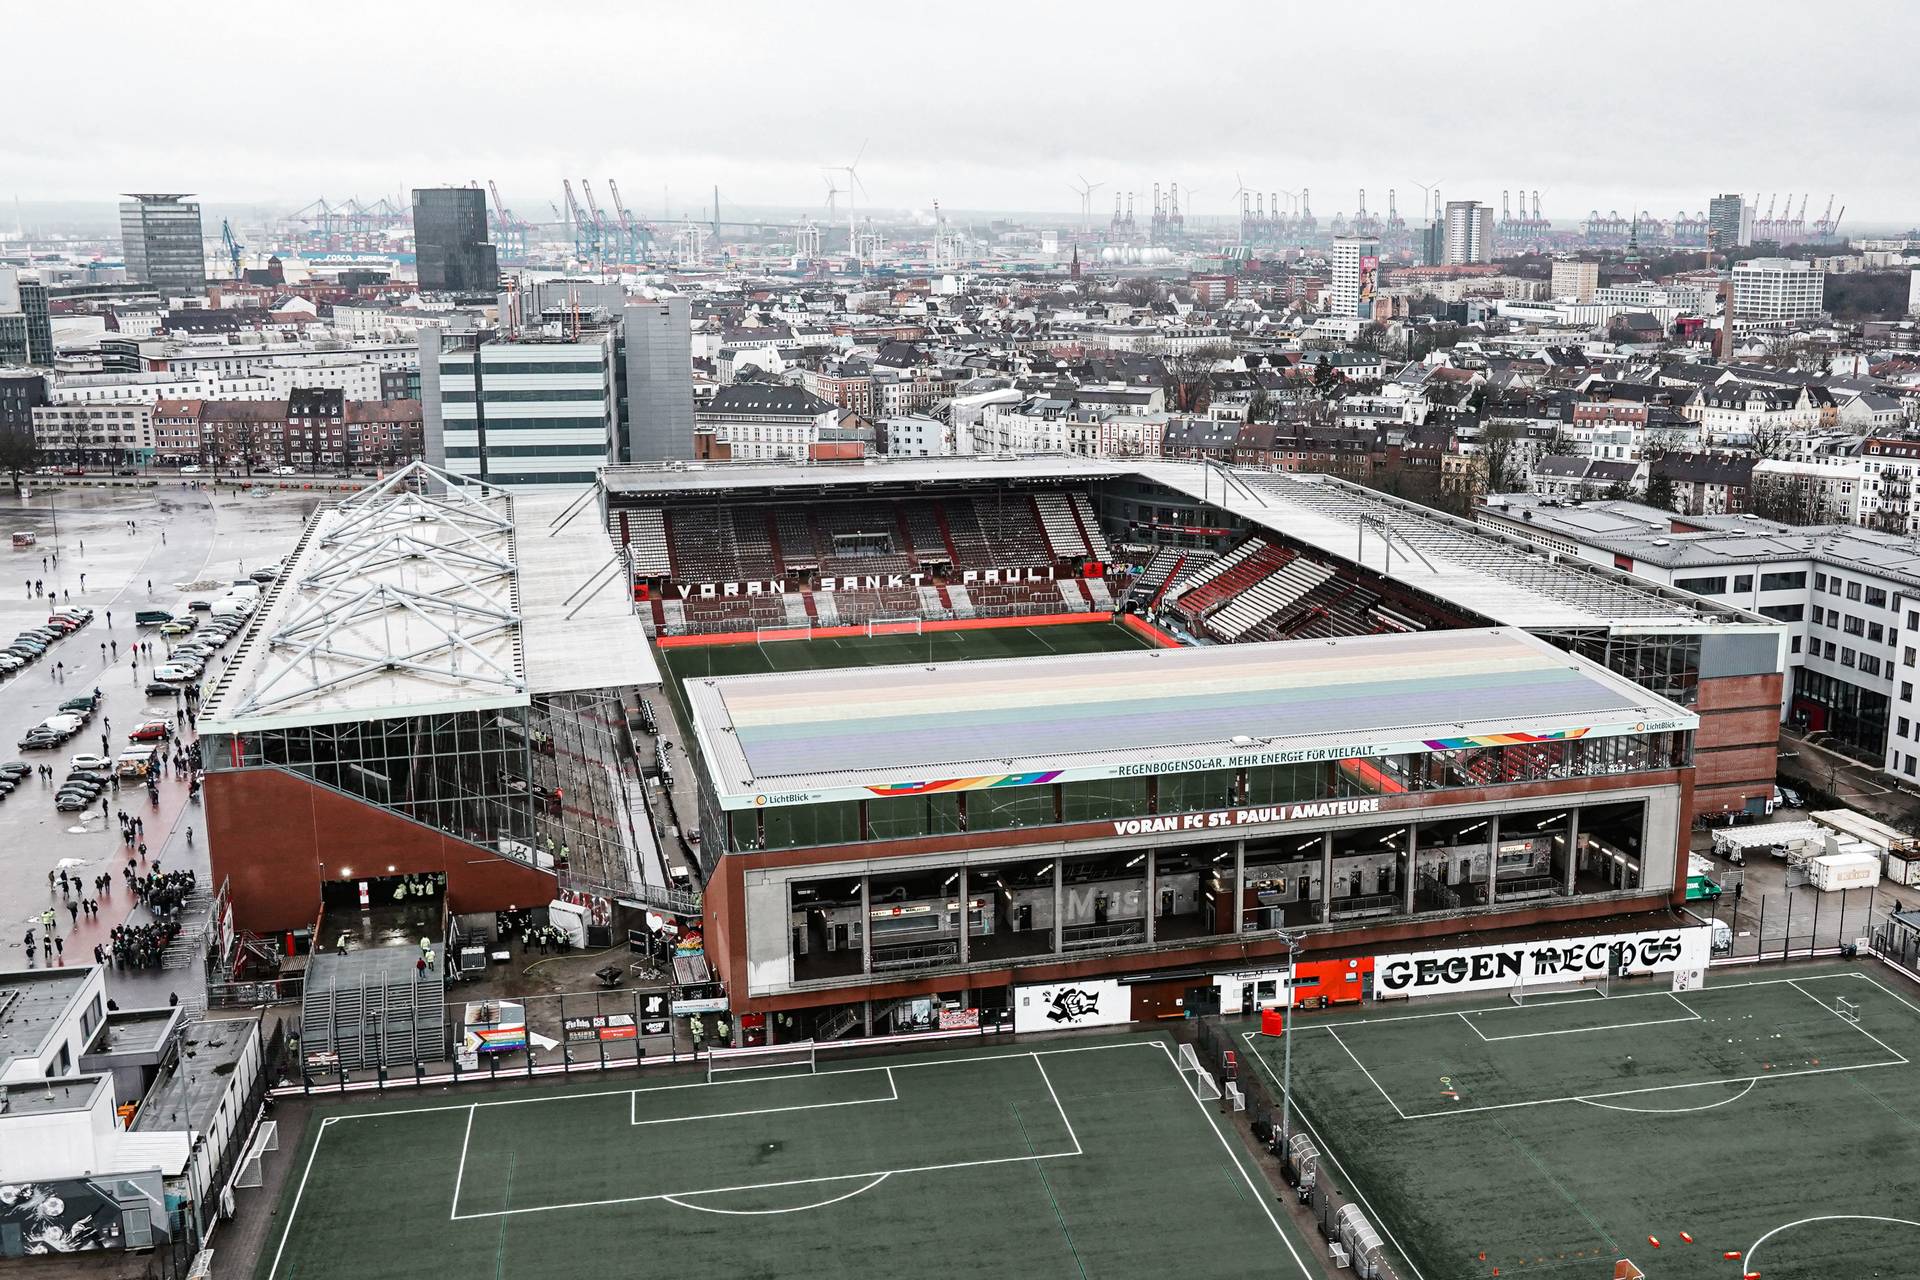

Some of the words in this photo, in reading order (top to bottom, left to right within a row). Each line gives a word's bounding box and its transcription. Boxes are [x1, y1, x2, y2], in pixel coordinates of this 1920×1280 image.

[677, 580, 785, 600] VORAN
[821, 574, 925, 592] SANKT
[963, 567, 1054, 585] PAULI
[1646, 721, 1675, 730] LichtBlick
[1118, 758, 1226, 776] REGENBOGENSOLAR.
[1229, 754, 1258, 767] MEHR
[1261, 751, 1304, 764] ENERGIE
[1306, 749, 1326, 760] FÜR
[1328, 745, 1375, 759] VIELFALT.
[769, 793, 808, 803] LichtBlick
[1114, 816, 1178, 835] VORAN
[1183, 814, 1204, 829] FC
[1208, 811, 1231, 827] ST.
[1237, 806, 1286, 824] PAULI
[1290, 799, 1379, 820] AMATEURE
[1382, 950, 1524, 990] GEGEN
[1530, 935, 1682, 976] RECHTS
